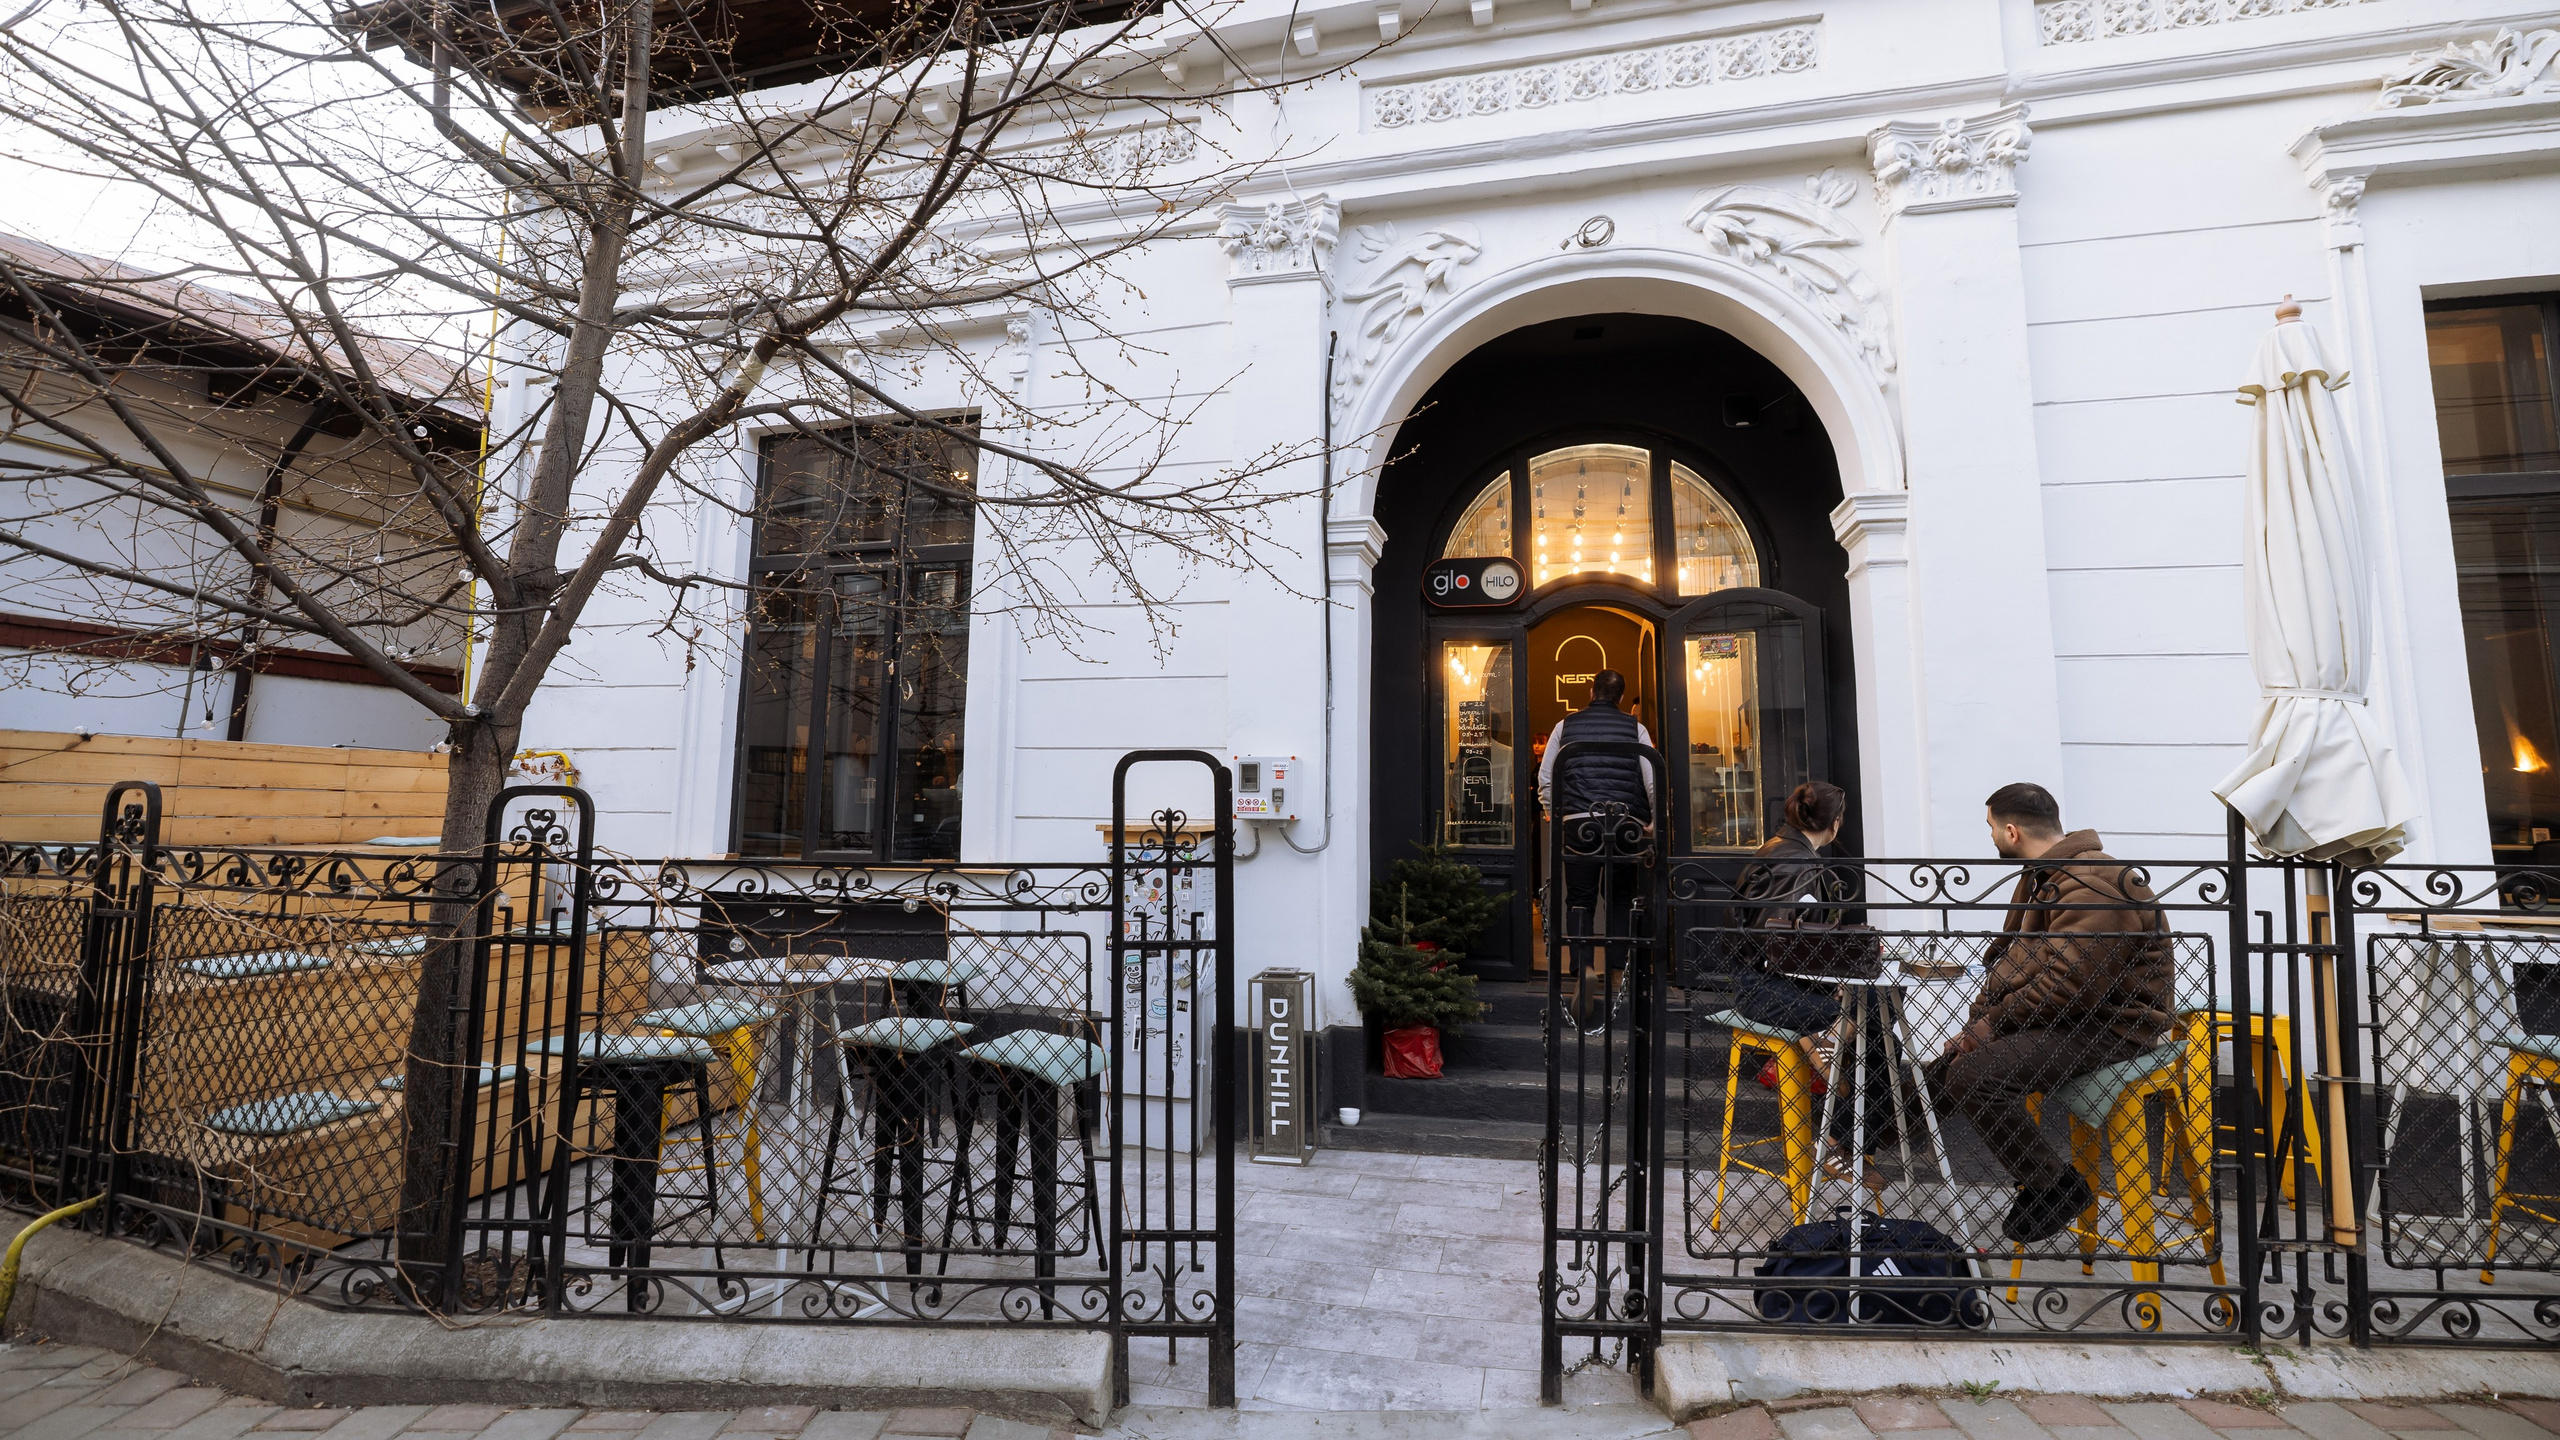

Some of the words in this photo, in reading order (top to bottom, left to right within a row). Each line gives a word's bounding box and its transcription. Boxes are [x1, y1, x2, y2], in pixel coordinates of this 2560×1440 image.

[1434, 569, 1470, 596] glo
[1485, 575, 1515, 588] HILO
[1555, 674, 1597, 684] NEGR
[1269, 998, 1291, 1136] DUNHILL
